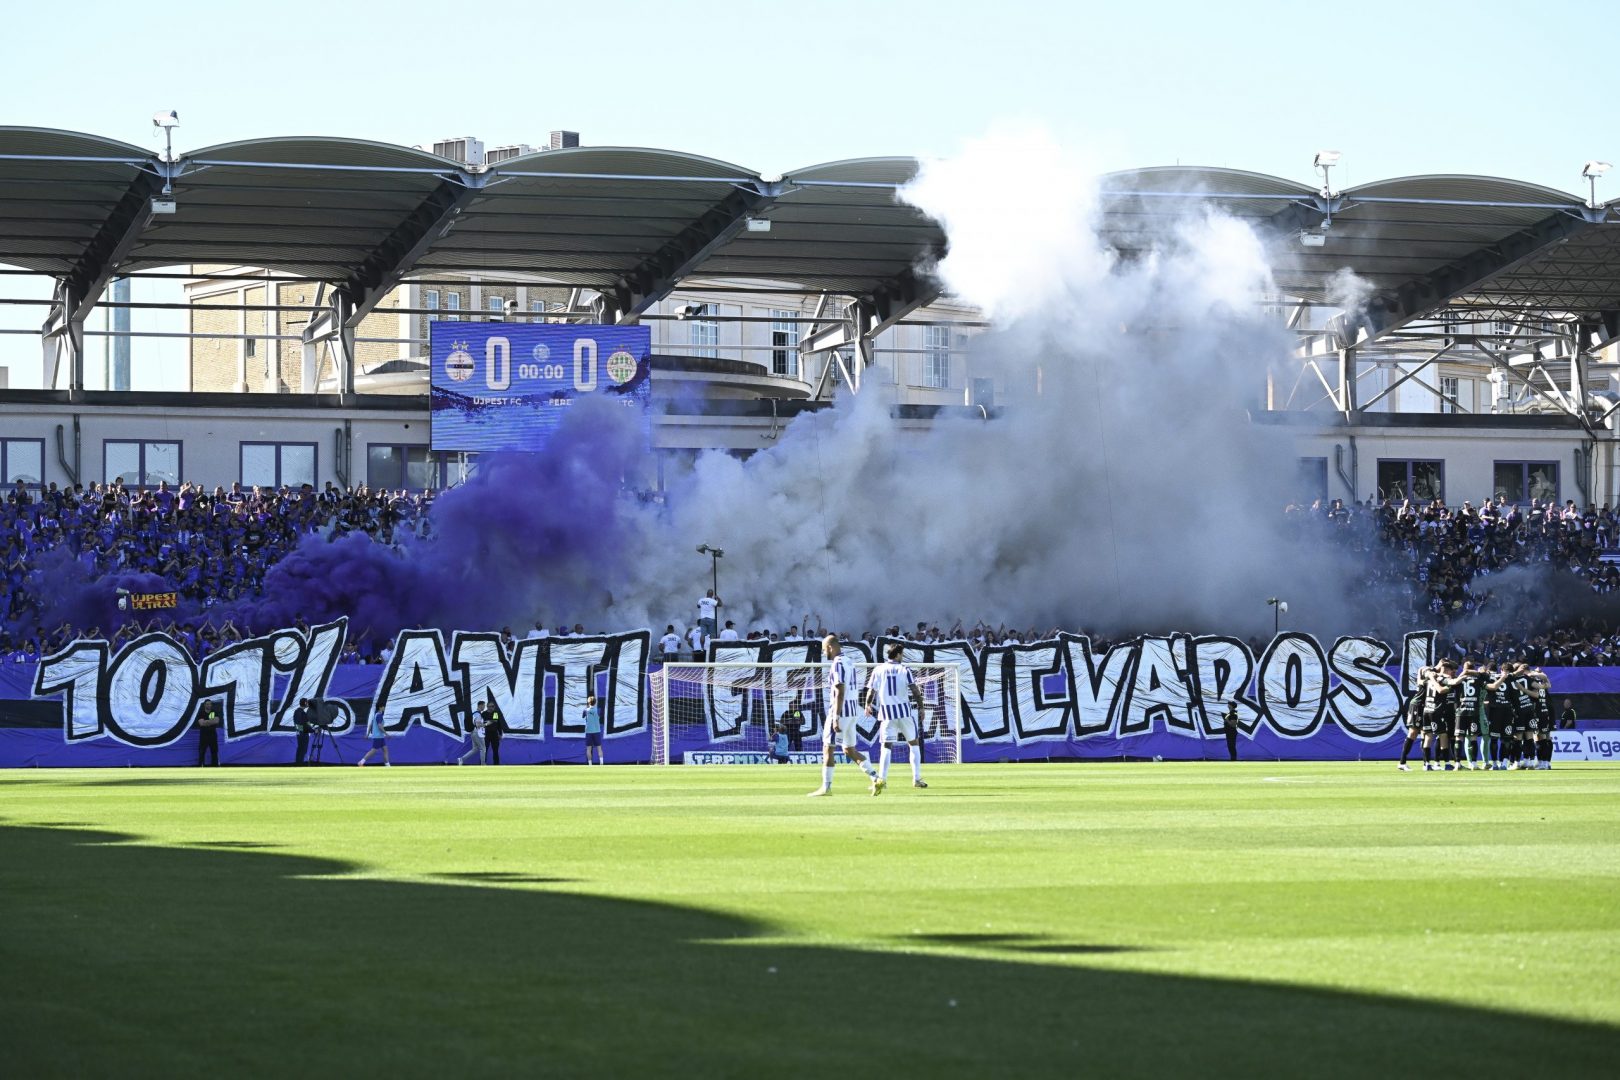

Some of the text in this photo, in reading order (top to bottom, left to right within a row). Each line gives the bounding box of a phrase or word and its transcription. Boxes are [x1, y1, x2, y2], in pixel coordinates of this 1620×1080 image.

[486, 336, 510, 390] 0
[519, 364, 563, 379] 00:00
[573, 338, 597, 391] 0
[132, 601, 176, 609] ULTRAS
[32, 616, 355, 748] 101%
[366, 628, 651, 742] ANTI
[887, 675, 897, 696] 11
[1461, 679, 1476, 697] 16
[1551, 735, 1620, 757] izz liga
